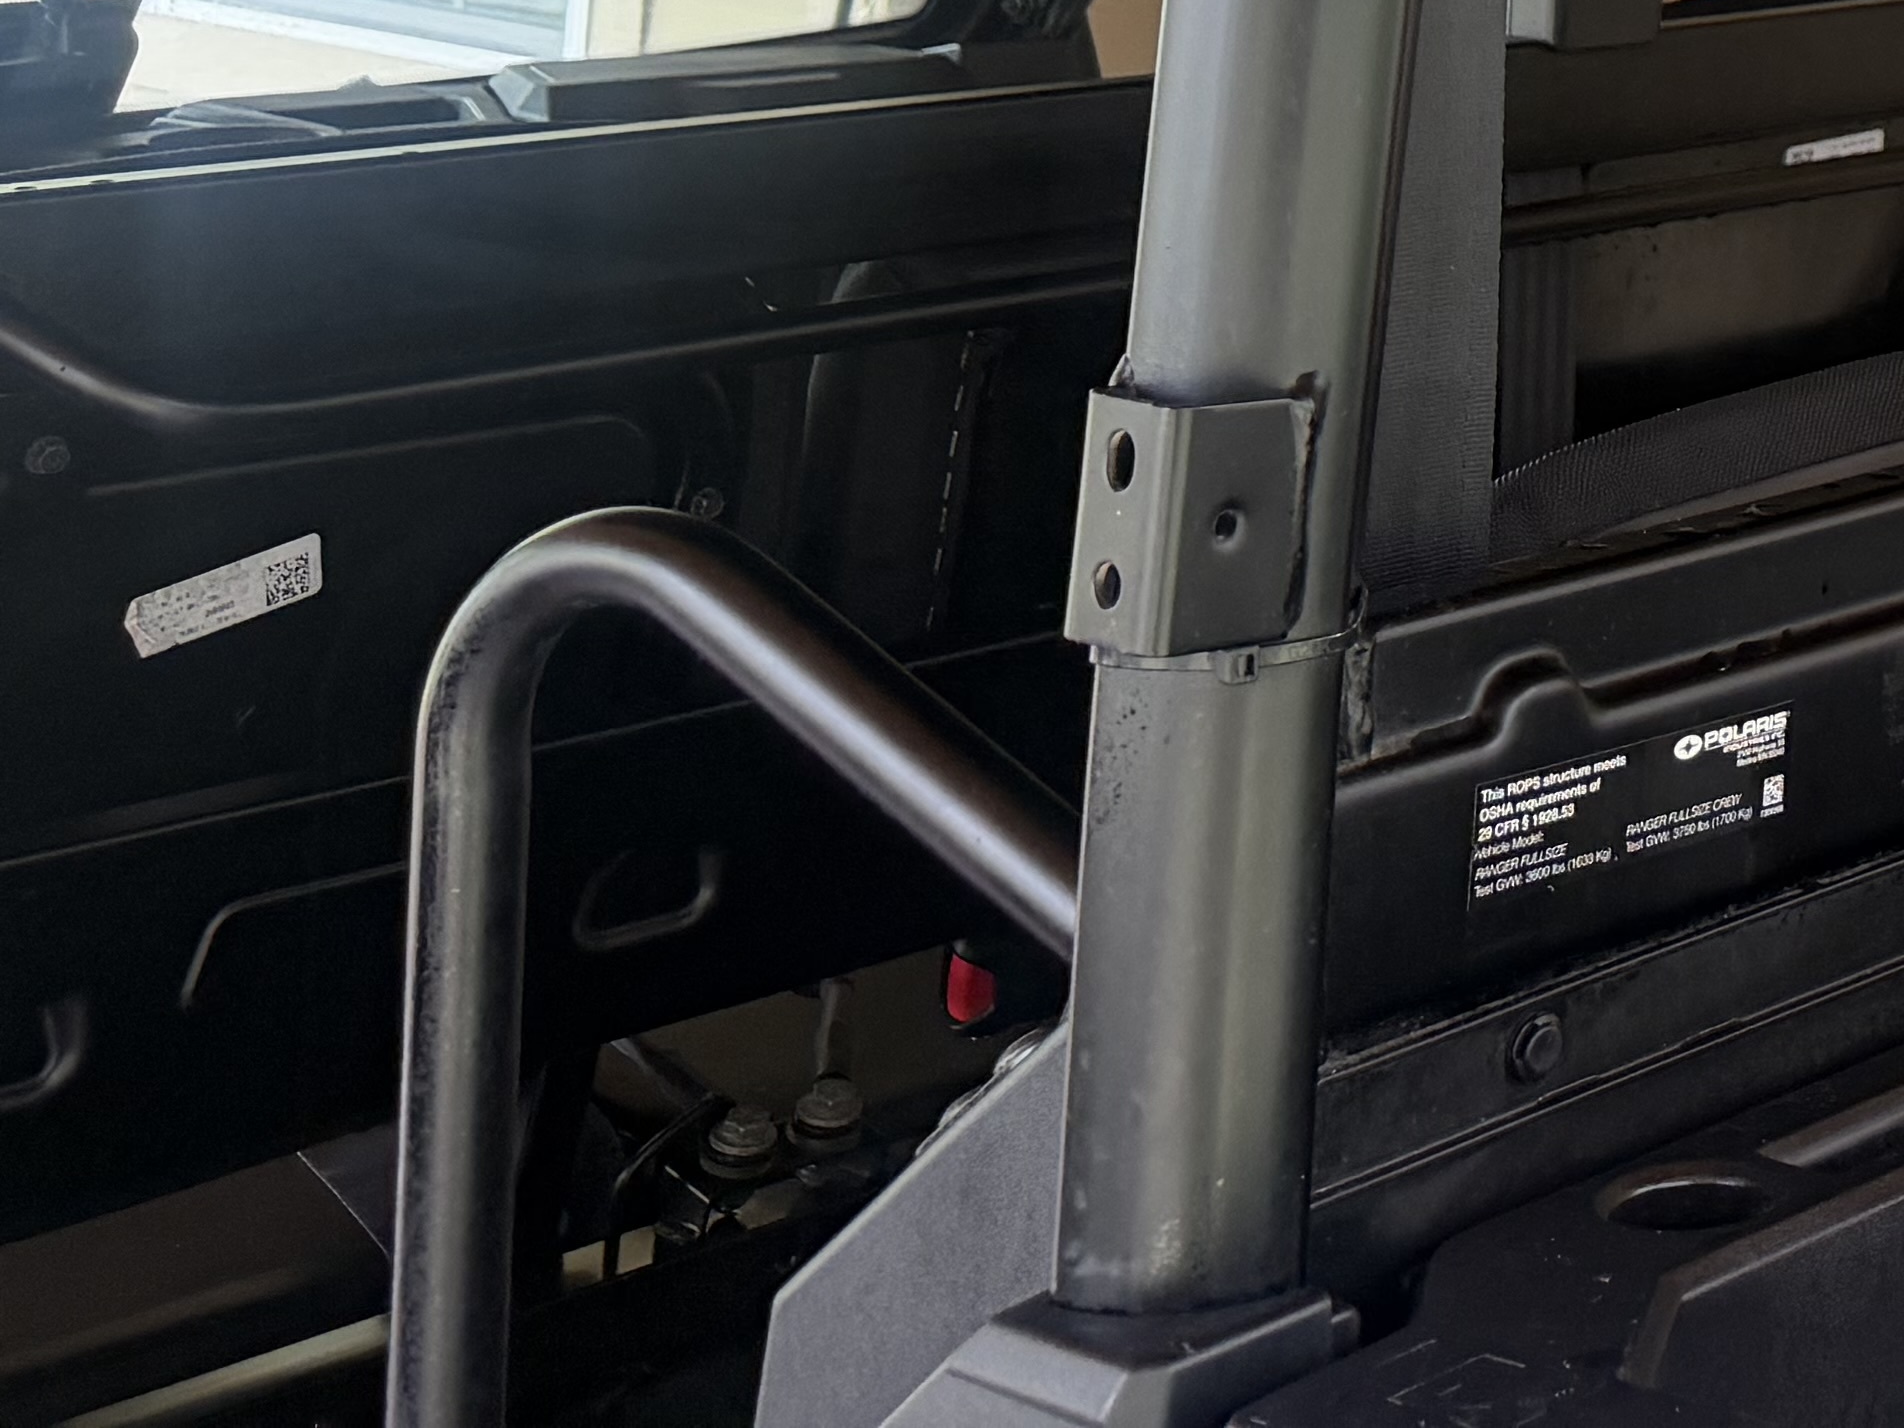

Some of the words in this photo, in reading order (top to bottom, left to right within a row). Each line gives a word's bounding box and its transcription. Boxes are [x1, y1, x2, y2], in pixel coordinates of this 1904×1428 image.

[1704, 710, 1788, 748] POLARIS
[1481, 786, 1505, 803] This
[1508, 776, 1541, 796] ROPS
[1543, 765, 1592, 787] structure
[1593, 754, 1627, 773] meets
[1479, 804, 1514, 822] OSHA
[1515, 784, 1587, 814] requirements
[1589, 777, 1602, 793] of
[1625, 814, 1667, 837] RANGER
[1668, 800, 1713, 825] FULLSIZE
[1713, 793, 1743, 812] CREW
[1478, 826, 1493, 842] 29
[1494, 819, 1520, 837] CFR
[1625, 838, 1644, 853] Test
[1474, 856, 1519, 881] RANGER
[1520, 842, 1569, 867] FULLSIZE
[1474, 883, 1494, 898] Test
